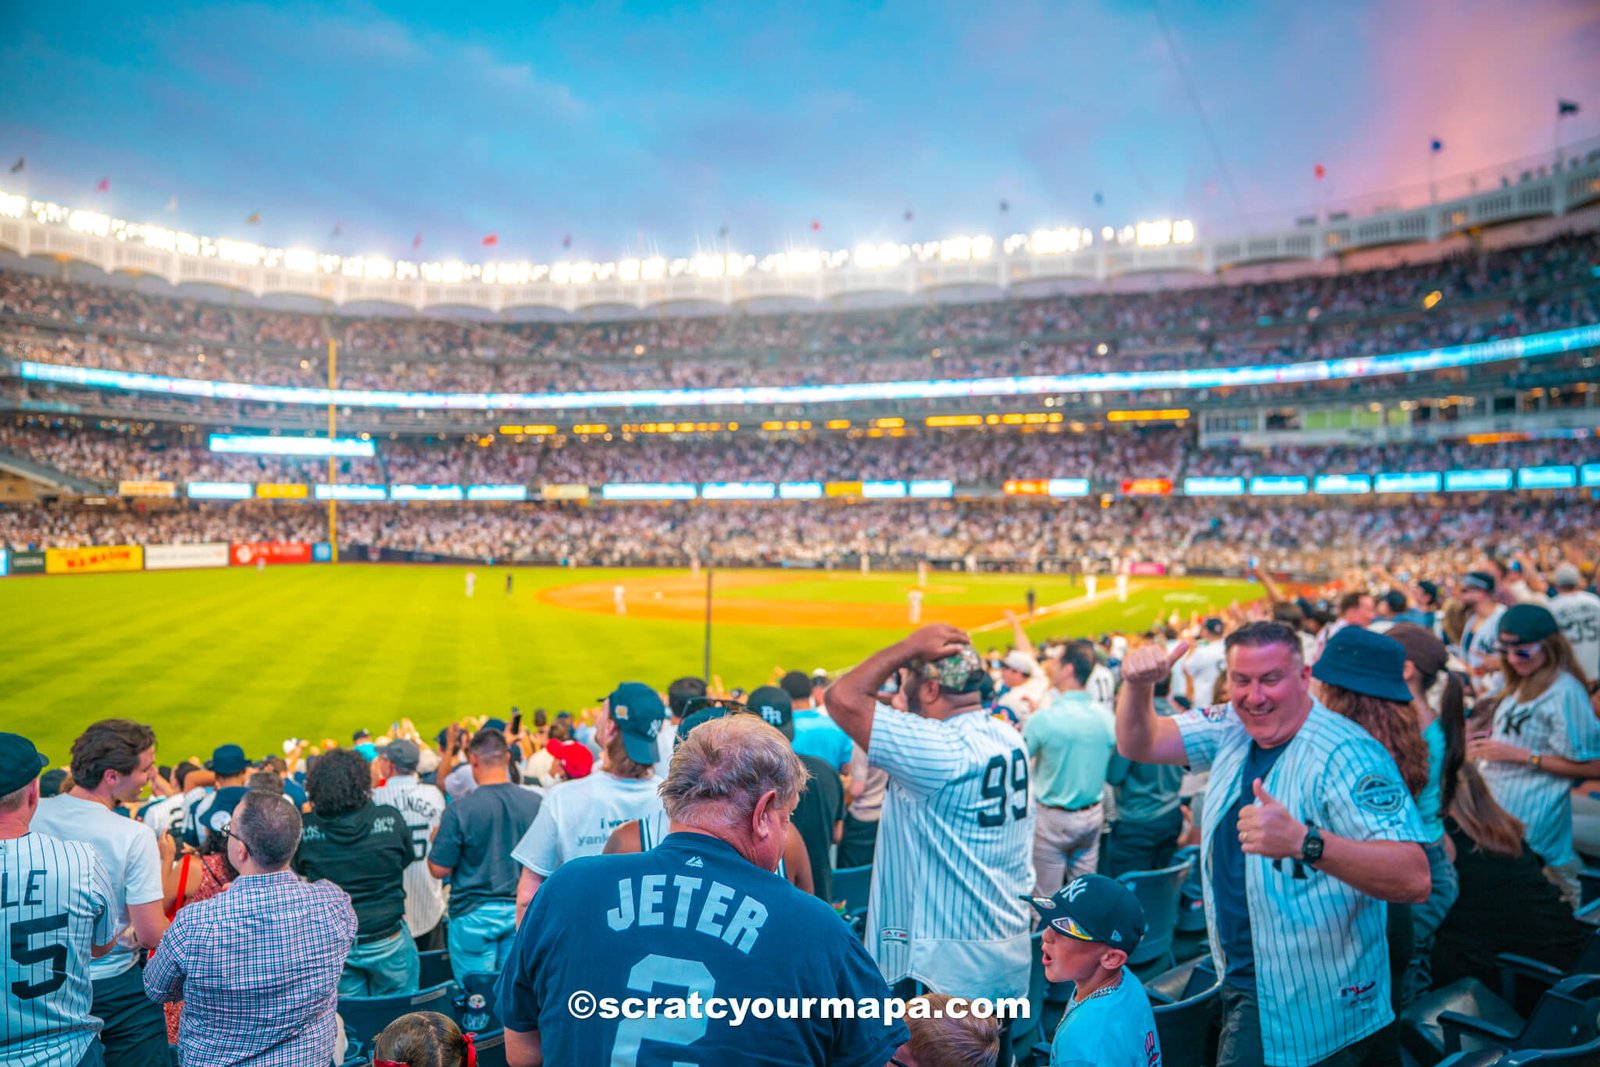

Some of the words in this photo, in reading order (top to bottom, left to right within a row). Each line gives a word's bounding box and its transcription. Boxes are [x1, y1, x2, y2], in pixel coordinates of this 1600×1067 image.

[977, 748, 1028, 828] 99
[606, 874, 769, 955] JETER
[1059, 878, 1089, 903] NY
[10, 912, 69, 1001] 5
[610, 953, 716, 1067] 2
